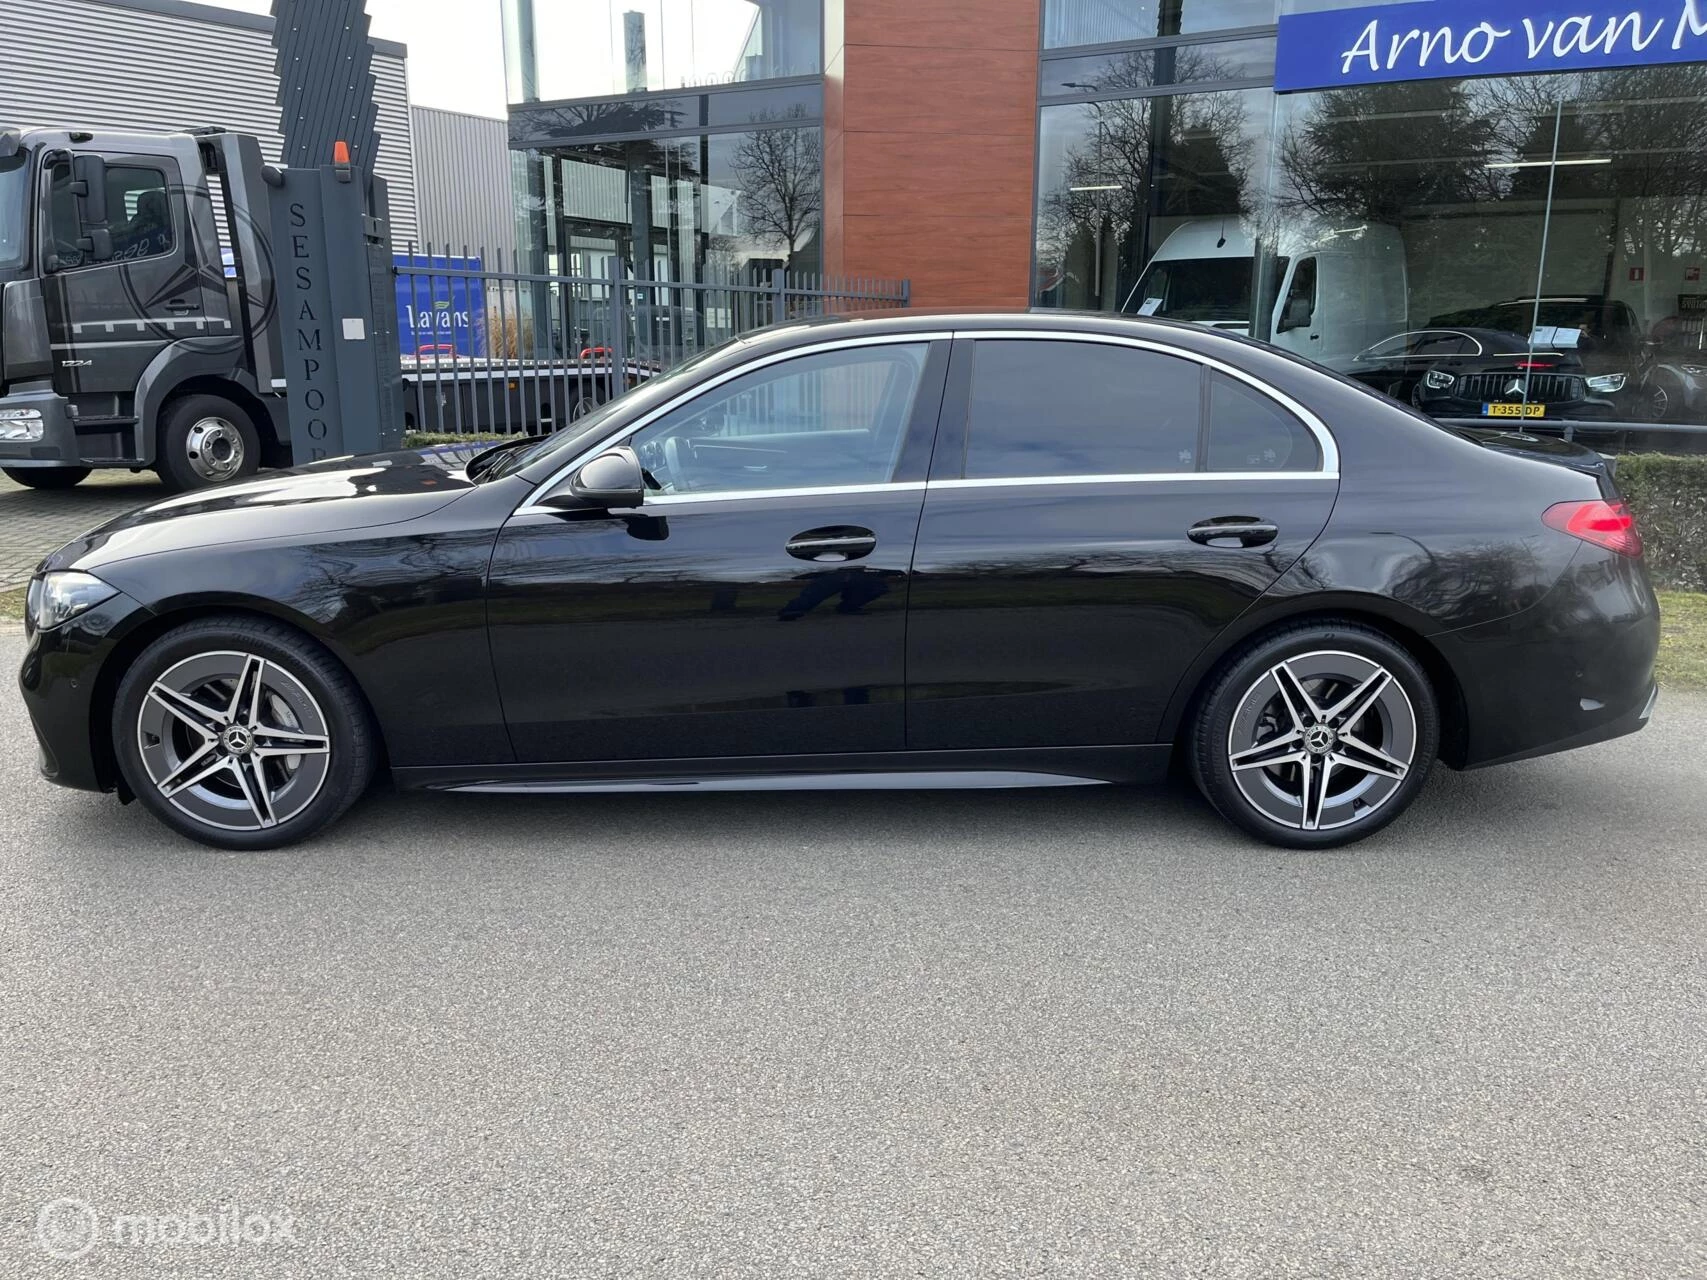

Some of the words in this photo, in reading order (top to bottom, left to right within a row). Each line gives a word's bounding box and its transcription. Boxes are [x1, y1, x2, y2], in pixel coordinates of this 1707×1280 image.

[1341, 19, 1511, 74] Arno
[1522, 11, 1664, 60] van
[1492, 405, 1540, 415] T-355DP
